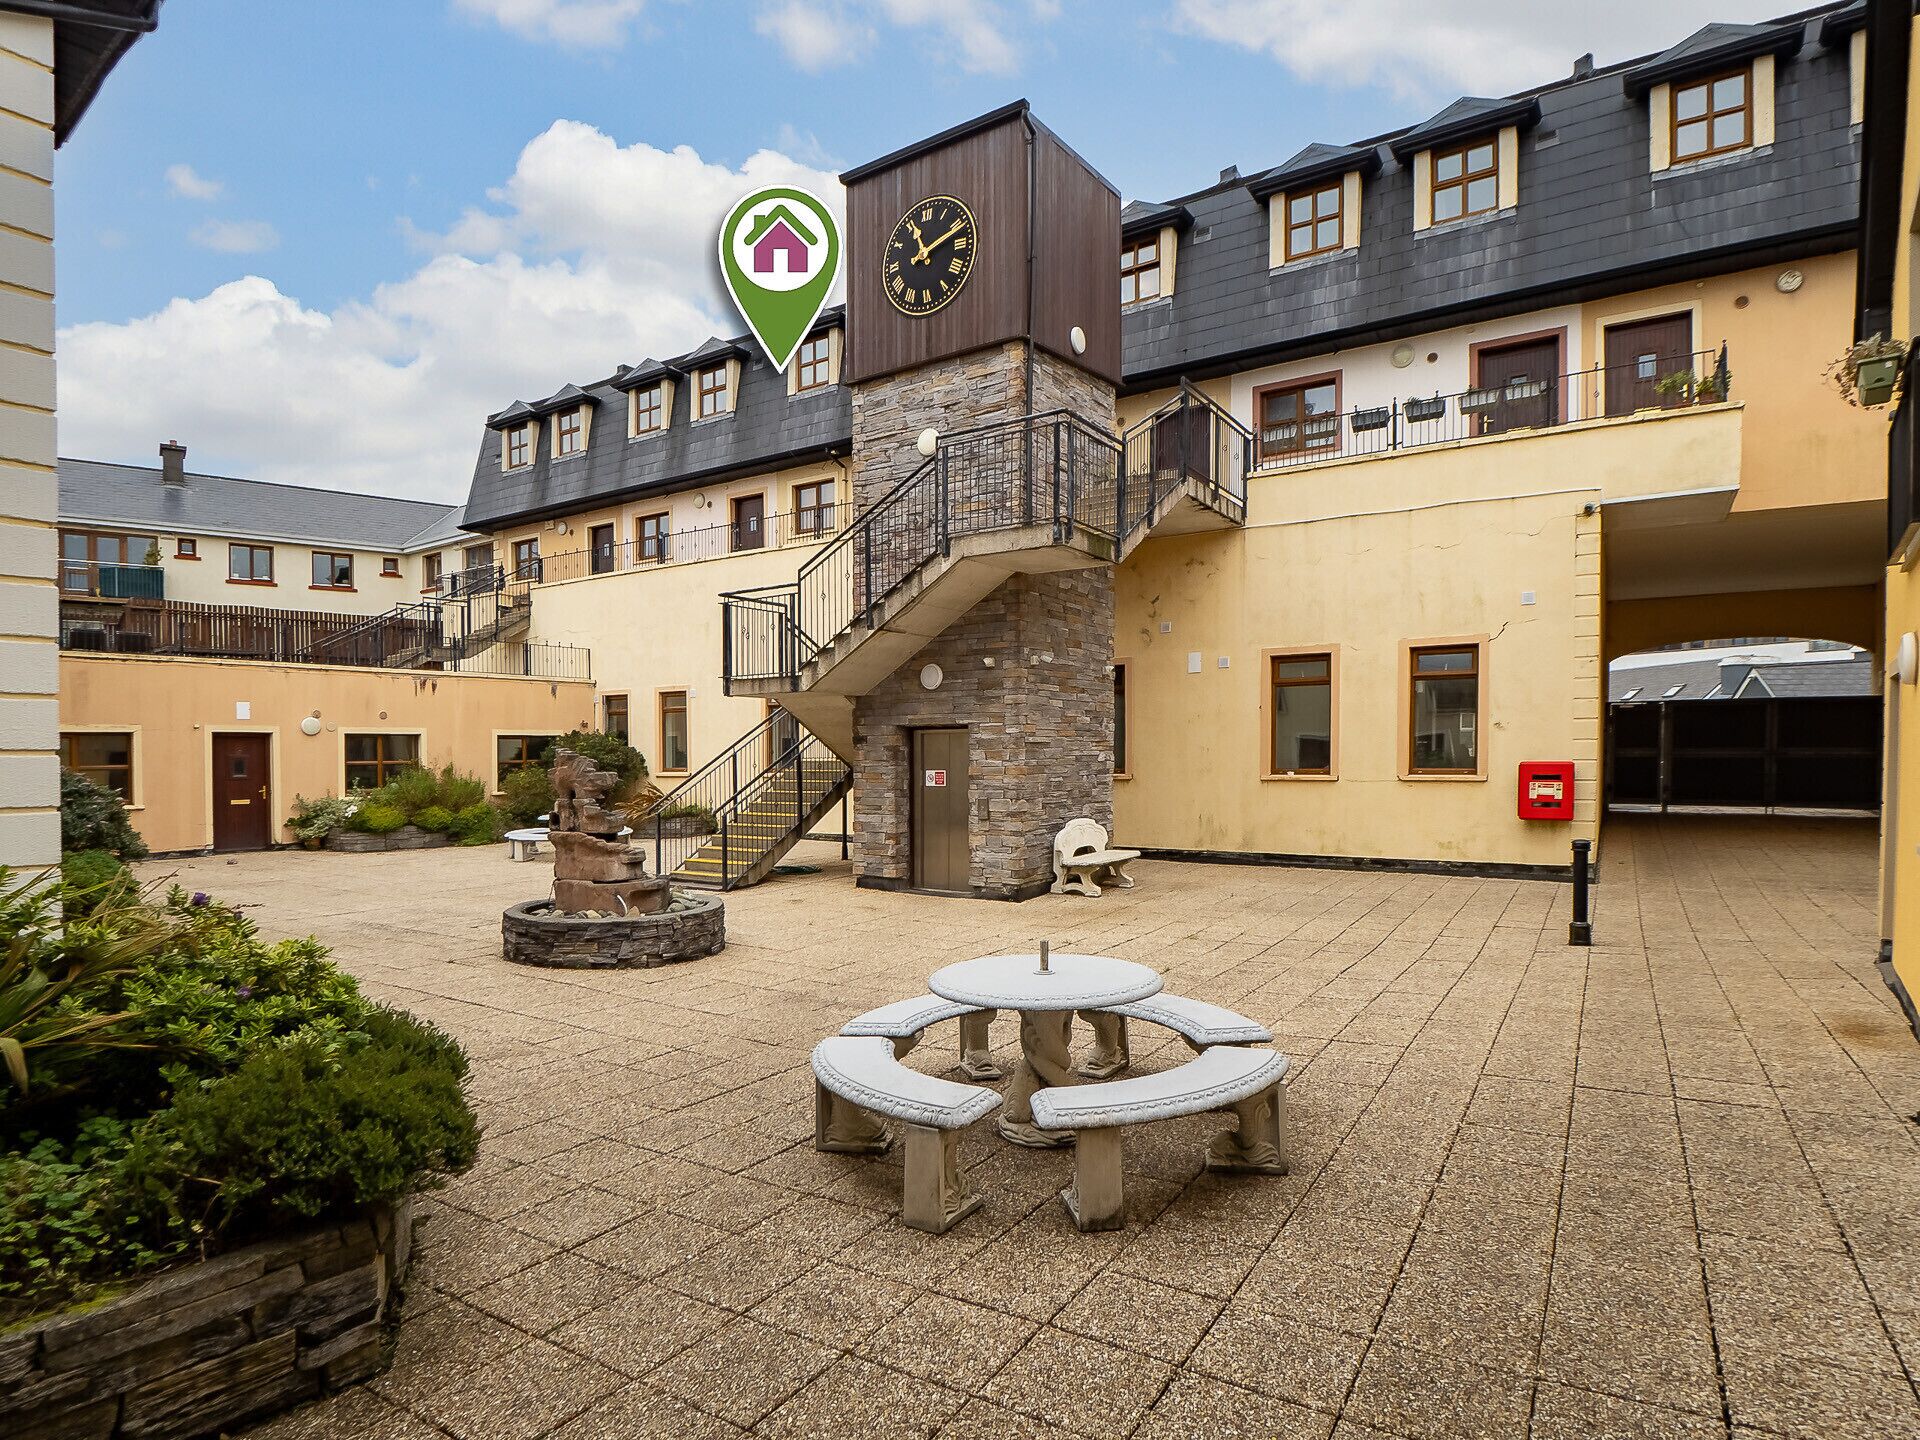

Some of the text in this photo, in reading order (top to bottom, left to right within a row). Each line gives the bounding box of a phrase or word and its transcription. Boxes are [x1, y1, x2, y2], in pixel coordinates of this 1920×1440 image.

[921, 207, 933, 222] XII
[893, 241, 903, 249] X
[954, 237, 967, 250] III
[889, 261, 899, 274] IX
[948, 257, 963, 274] IIII
[892, 275, 905, 295] VIII
[940, 280, 949, 292] V
[905, 288, 915, 303] VII
[922, 289, 932, 303] VI
